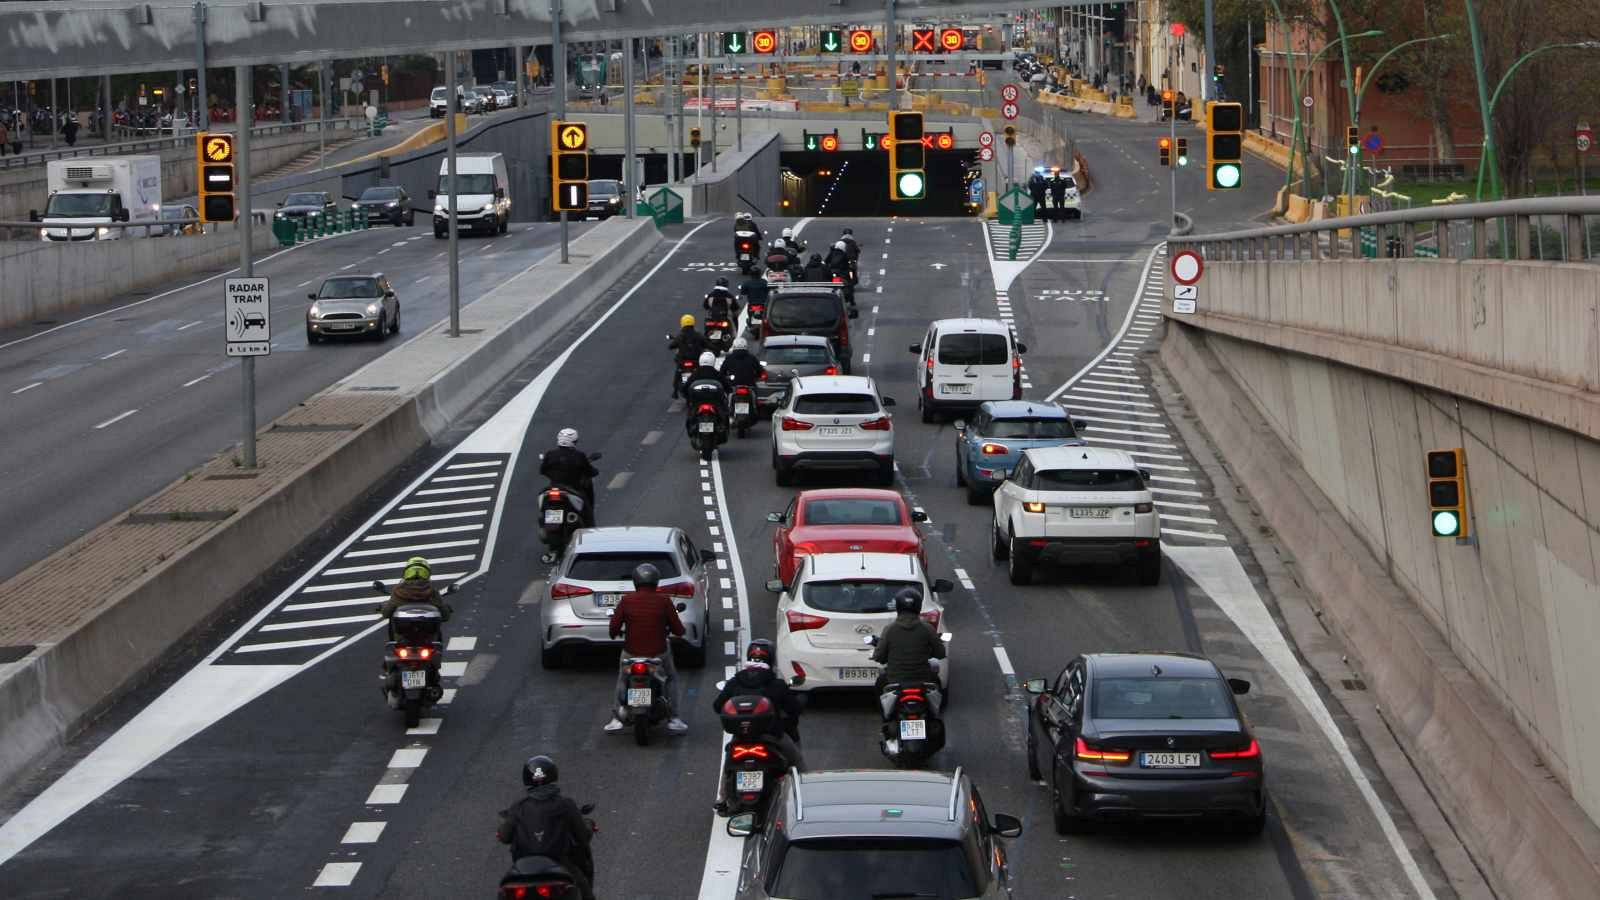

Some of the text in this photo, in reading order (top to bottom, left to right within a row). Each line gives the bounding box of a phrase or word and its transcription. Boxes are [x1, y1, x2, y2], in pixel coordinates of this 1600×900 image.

[758, 37, 770, 47] 30
[855, 36, 866, 46] 30
[945, 35, 957, 44] 30
[229, 284, 265, 292] RADAR
[233, 295, 262, 304] TRAM
[845, 670, 868, 679] 8936
[1147, 754, 1198, 764] 2403 LFY
